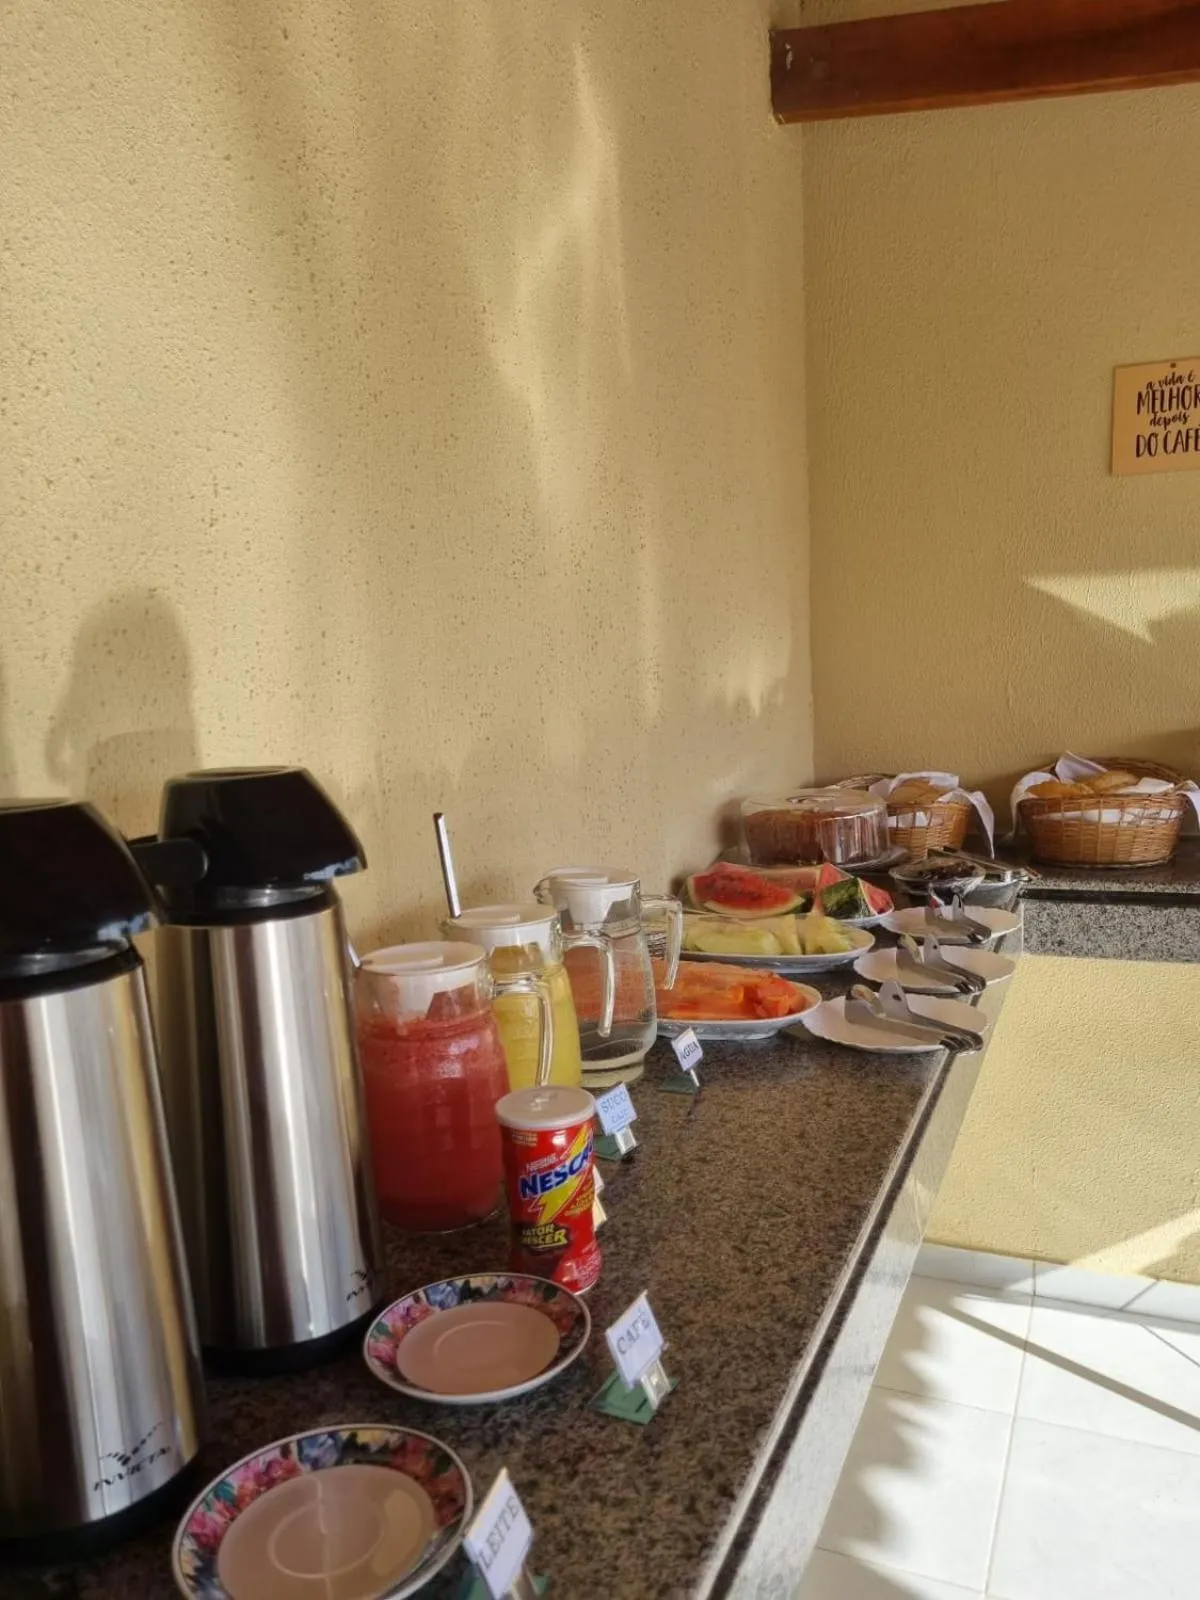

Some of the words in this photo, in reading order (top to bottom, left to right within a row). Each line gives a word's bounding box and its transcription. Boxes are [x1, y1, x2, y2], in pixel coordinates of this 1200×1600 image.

[1158, 371, 1184, 388] vida
[1149, 411, 1190, 431] depois
[1135, 432, 1159, 458] DO
[478, 1494, 521, 1571] LEITE
